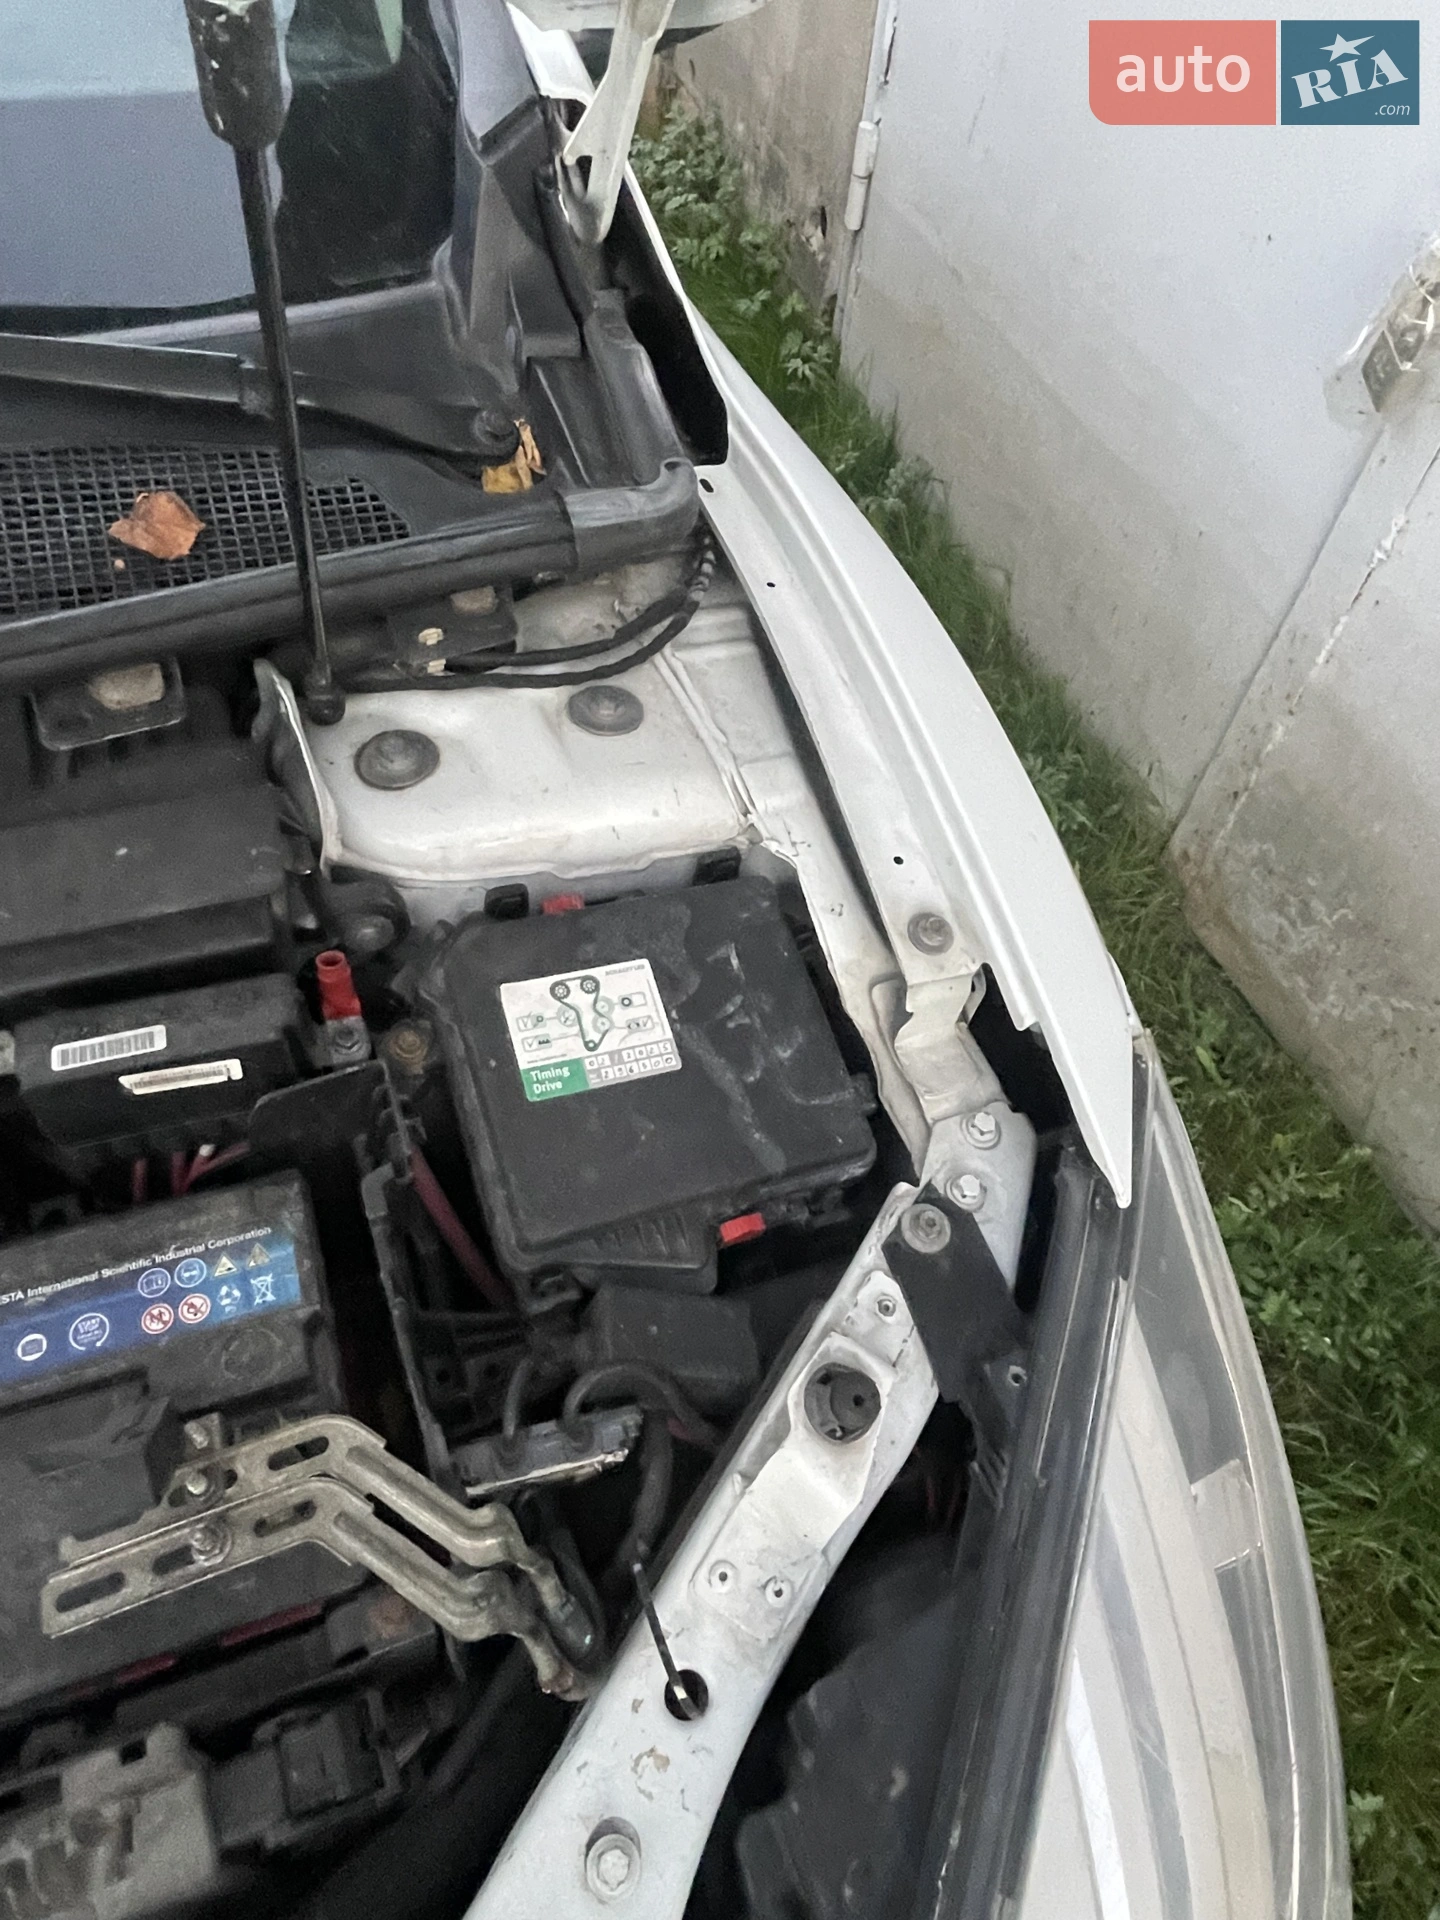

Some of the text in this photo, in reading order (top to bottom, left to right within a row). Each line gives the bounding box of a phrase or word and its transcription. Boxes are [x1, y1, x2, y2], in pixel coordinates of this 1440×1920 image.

[530, 1066, 571, 1081] Timing
[533, 1080, 563, 1095] Drive
[0, 1227, 271, 1306] STA International Scientific Industrial Corporation
